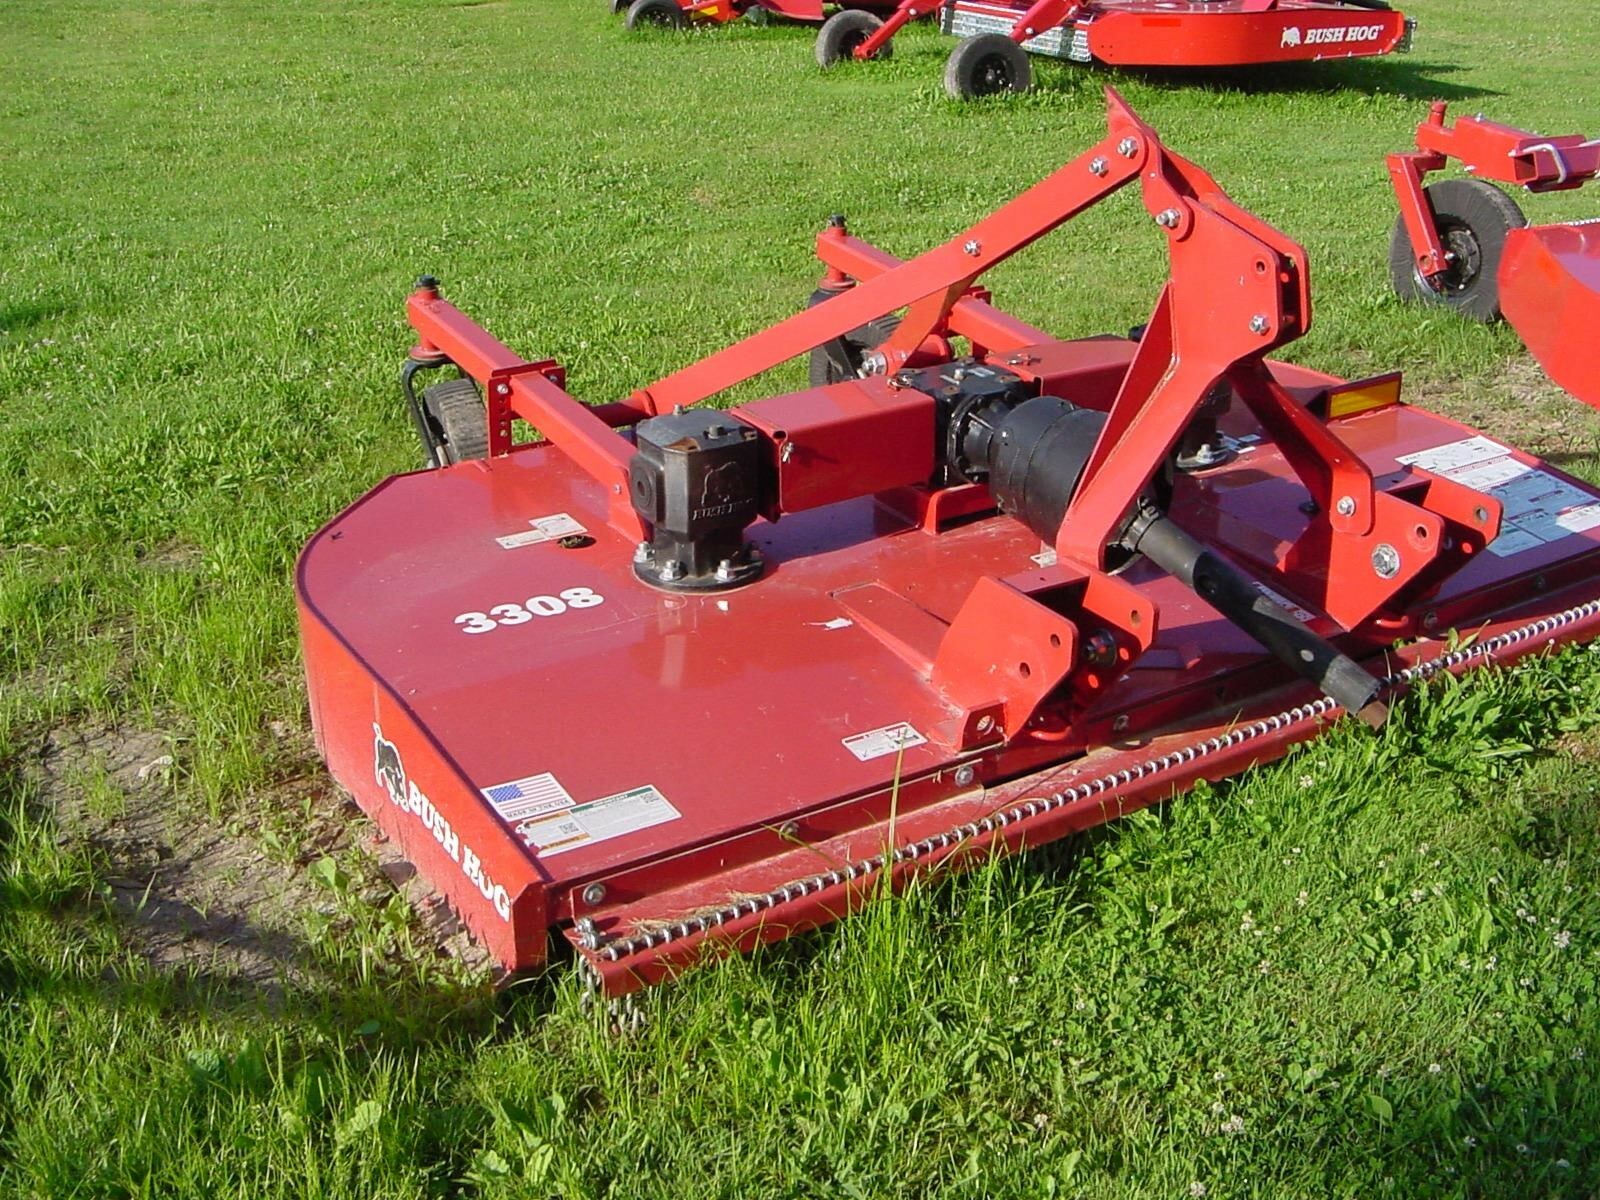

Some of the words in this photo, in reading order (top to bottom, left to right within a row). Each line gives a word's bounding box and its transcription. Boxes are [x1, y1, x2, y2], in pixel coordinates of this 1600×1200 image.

[1304, 28, 1346, 44] BUSH
[454, 586, 605, 634] 3308
[408, 780, 460, 863] BUSH
[462, 844, 511, 923] HOG
